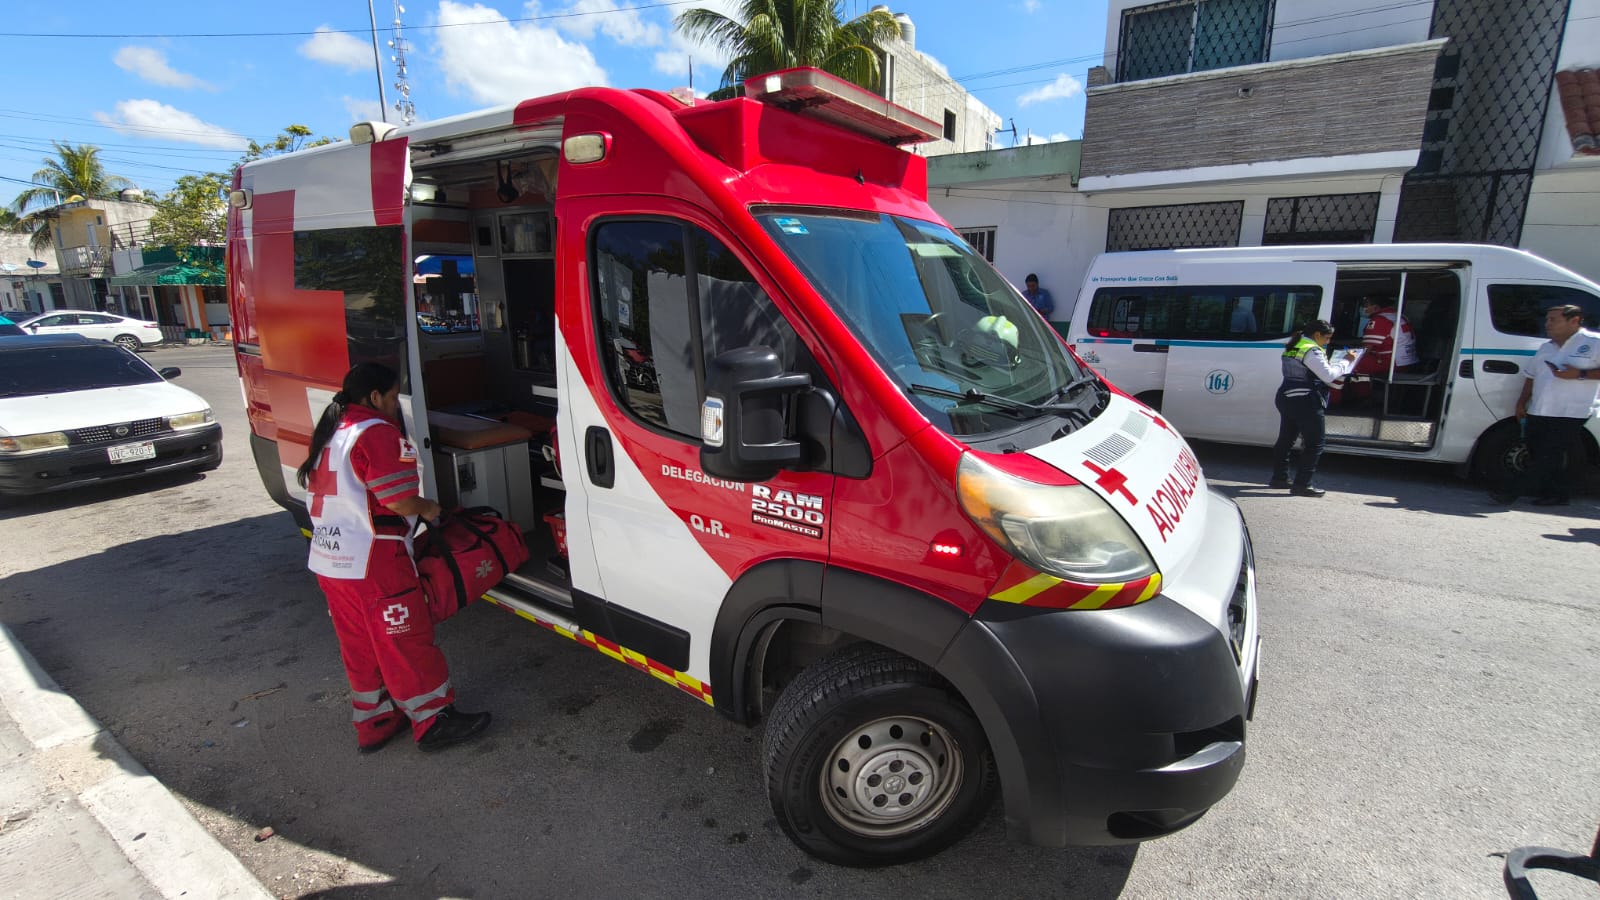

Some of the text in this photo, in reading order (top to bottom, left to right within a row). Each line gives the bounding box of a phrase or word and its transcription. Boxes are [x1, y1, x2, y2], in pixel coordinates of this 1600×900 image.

[1208, 373, 1229, 391] 164
[752, 484, 823, 510] RAM
[752, 498, 824, 525] 2500
[689, 514, 731, 539] Q.R.
